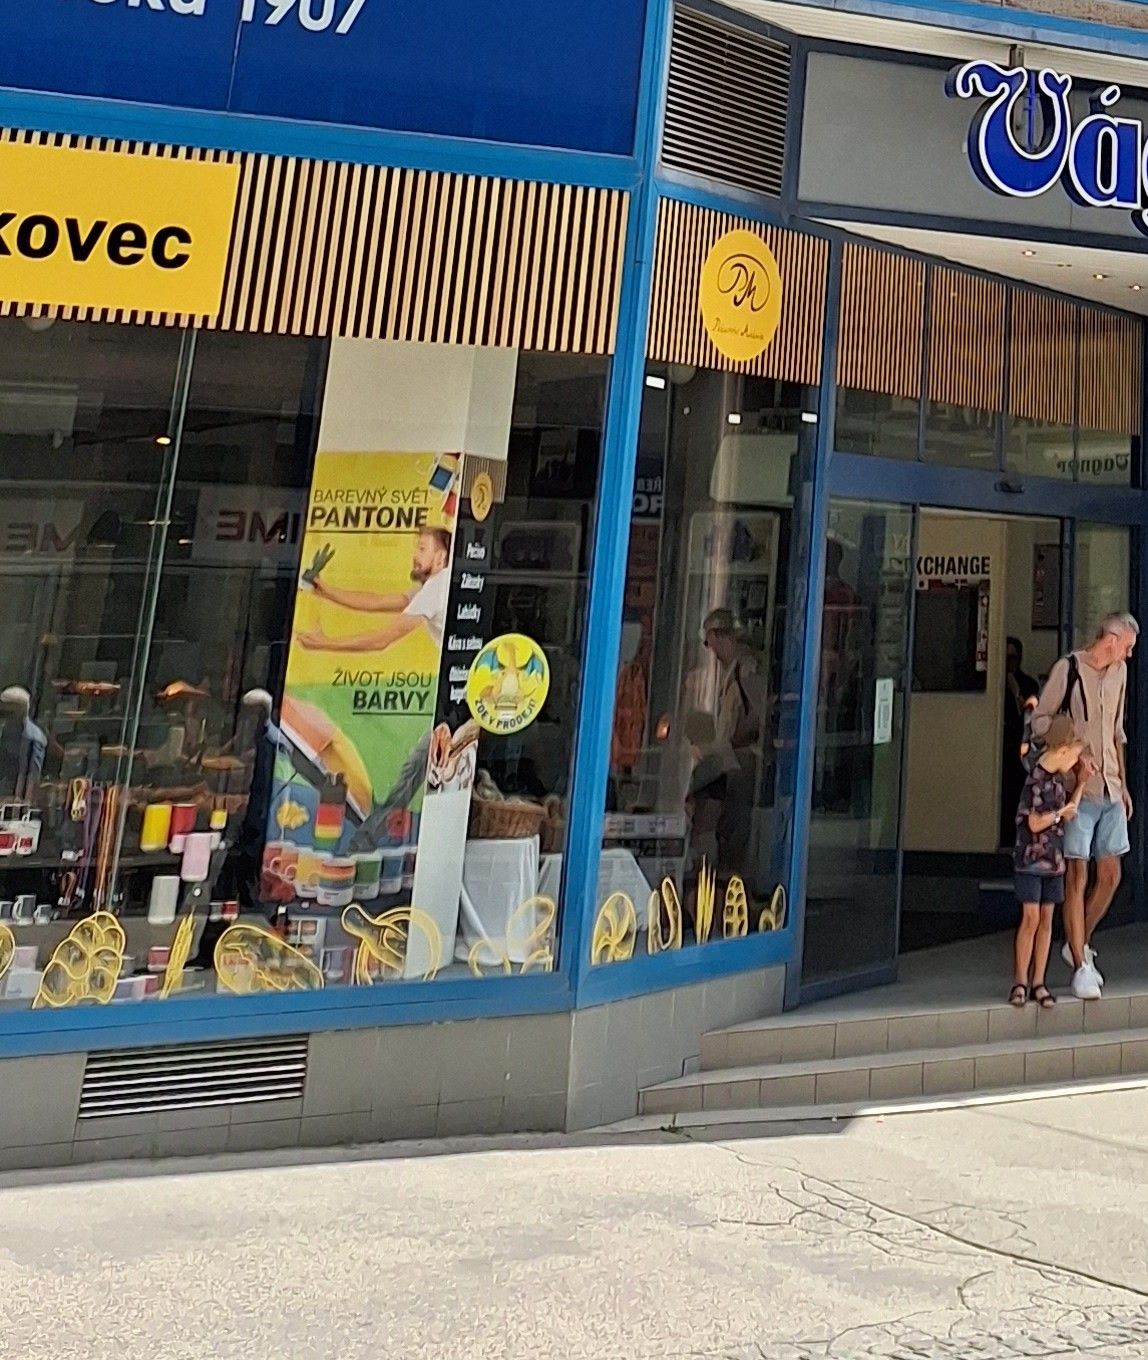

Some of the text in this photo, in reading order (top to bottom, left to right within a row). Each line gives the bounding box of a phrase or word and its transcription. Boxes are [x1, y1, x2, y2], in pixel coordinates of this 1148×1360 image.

[313, 486, 387, 505] BAREVNÝ
[309, 505, 430, 529] PANTONE
[332, 667, 384, 687] ŽIVOT
[386, 671, 432, 688] JSOU
[353, 690, 430, 711] BARVY
